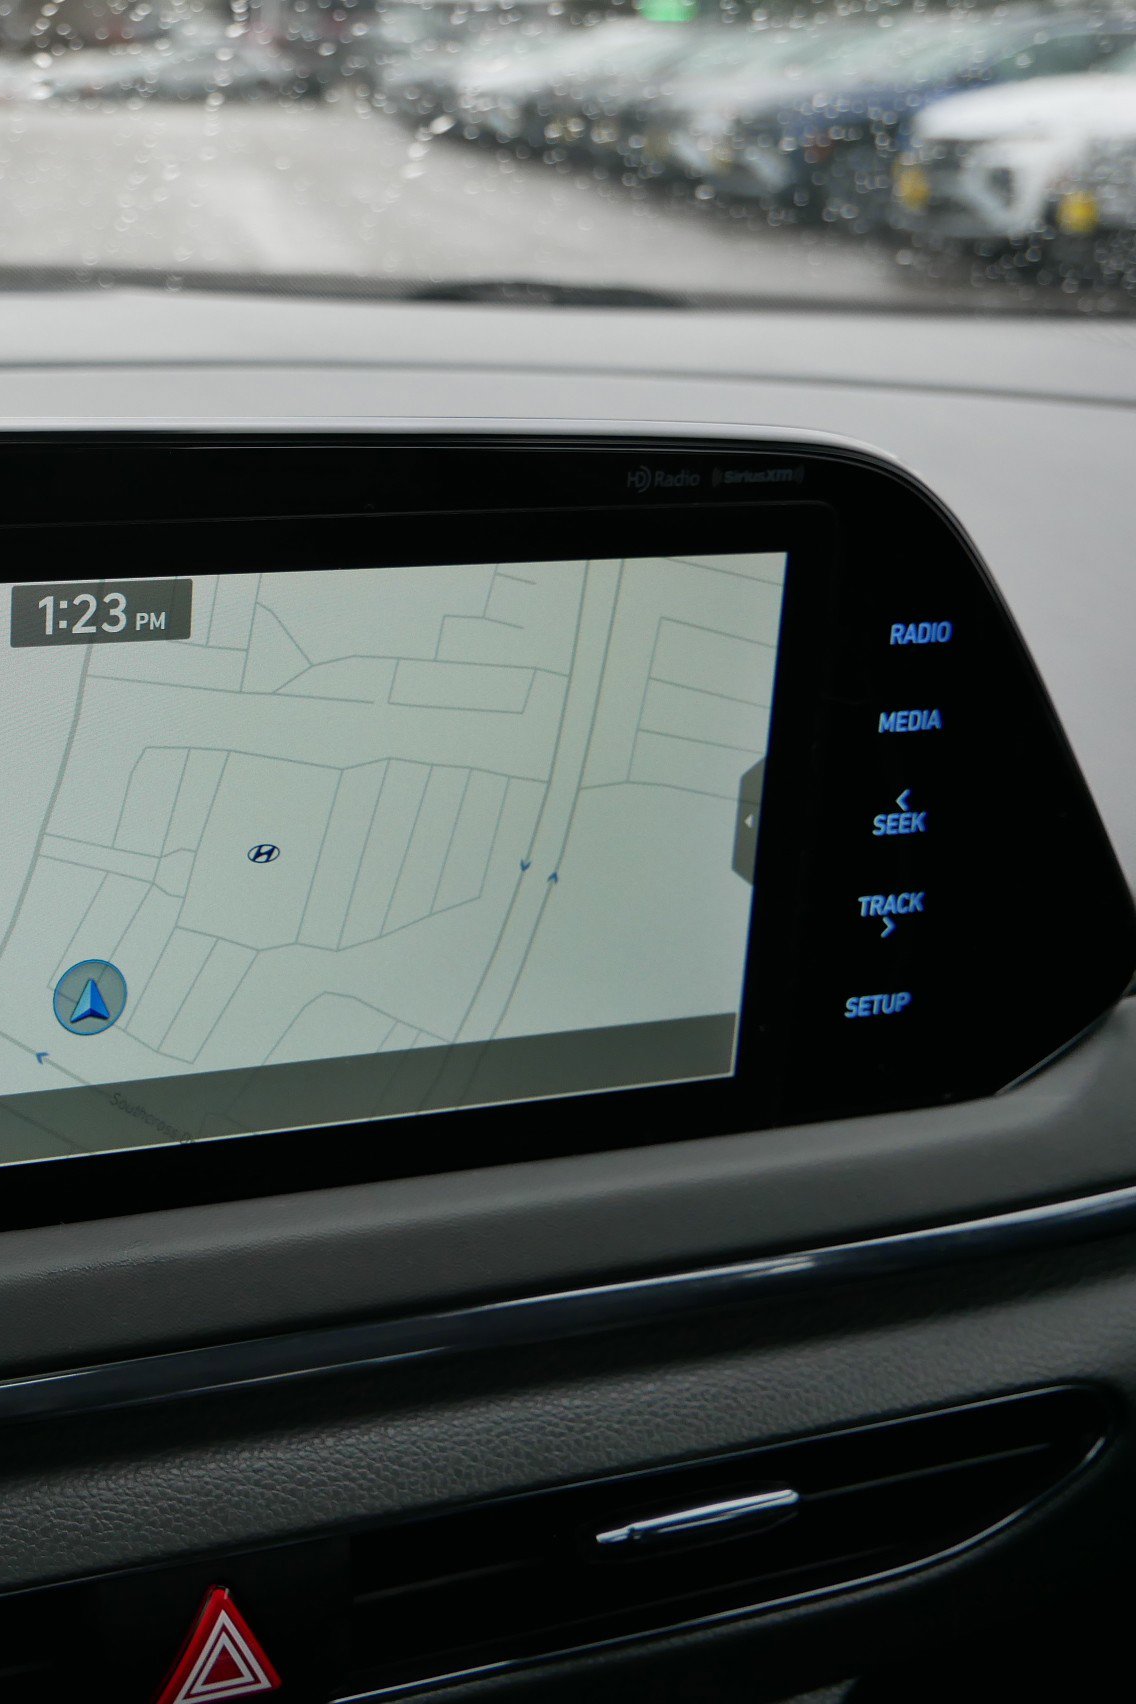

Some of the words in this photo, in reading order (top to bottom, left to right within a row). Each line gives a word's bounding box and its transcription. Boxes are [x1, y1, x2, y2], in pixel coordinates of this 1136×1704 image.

[654, 469, 701, 488] Radio
[37, 592, 127, 635] 1:23
[135, 611, 166, 631] PM
[889, 620, 952, 645] RADIO
[878, 708, 943, 733] MEDIA
[872, 811, 927, 836] SEEK
[858, 891, 925, 917] TRACK
[844, 991, 912, 1018] SETUP
